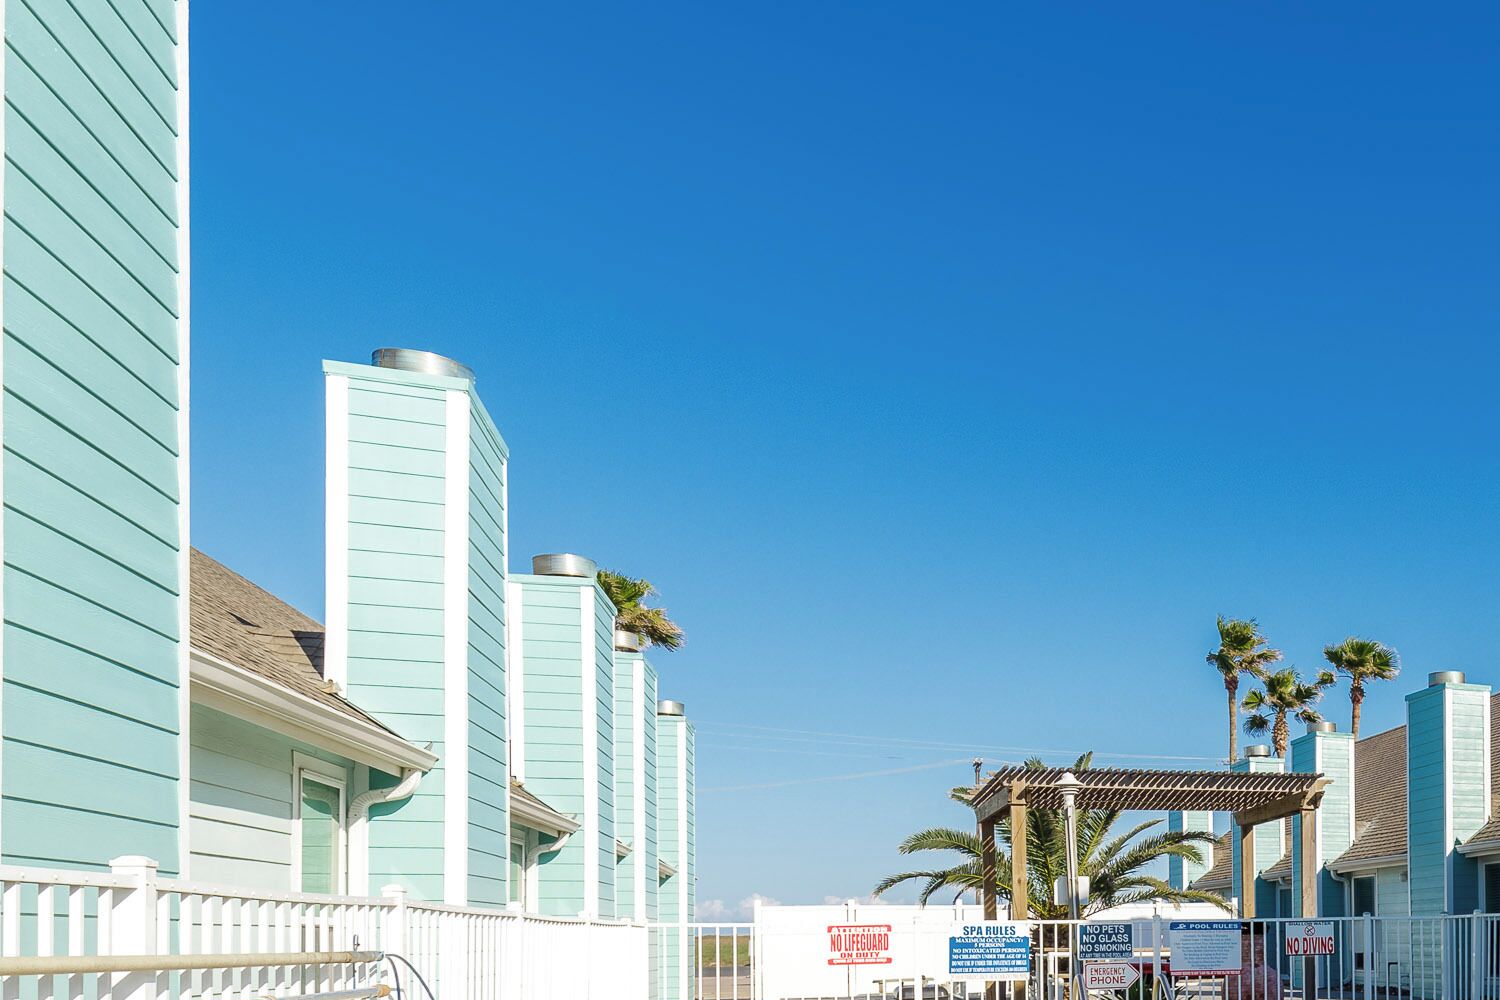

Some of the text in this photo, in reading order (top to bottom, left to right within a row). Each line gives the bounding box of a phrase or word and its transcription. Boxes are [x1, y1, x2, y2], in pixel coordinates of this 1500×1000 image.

[963, 926, 1016, 935] SPA RULES
[1086, 925, 1125, 934] NO PETS
[831, 933, 889, 952] NO LIFEGUARD
[1083, 934, 1129, 943] NO GLASS
[1080, 944, 1131, 952] NO SMOKING
[1287, 936, 1333, 955] NO DIVING
[1090, 967, 1126, 975] EMERGENCY
[1090, 975, 1126, 984] PHONE
